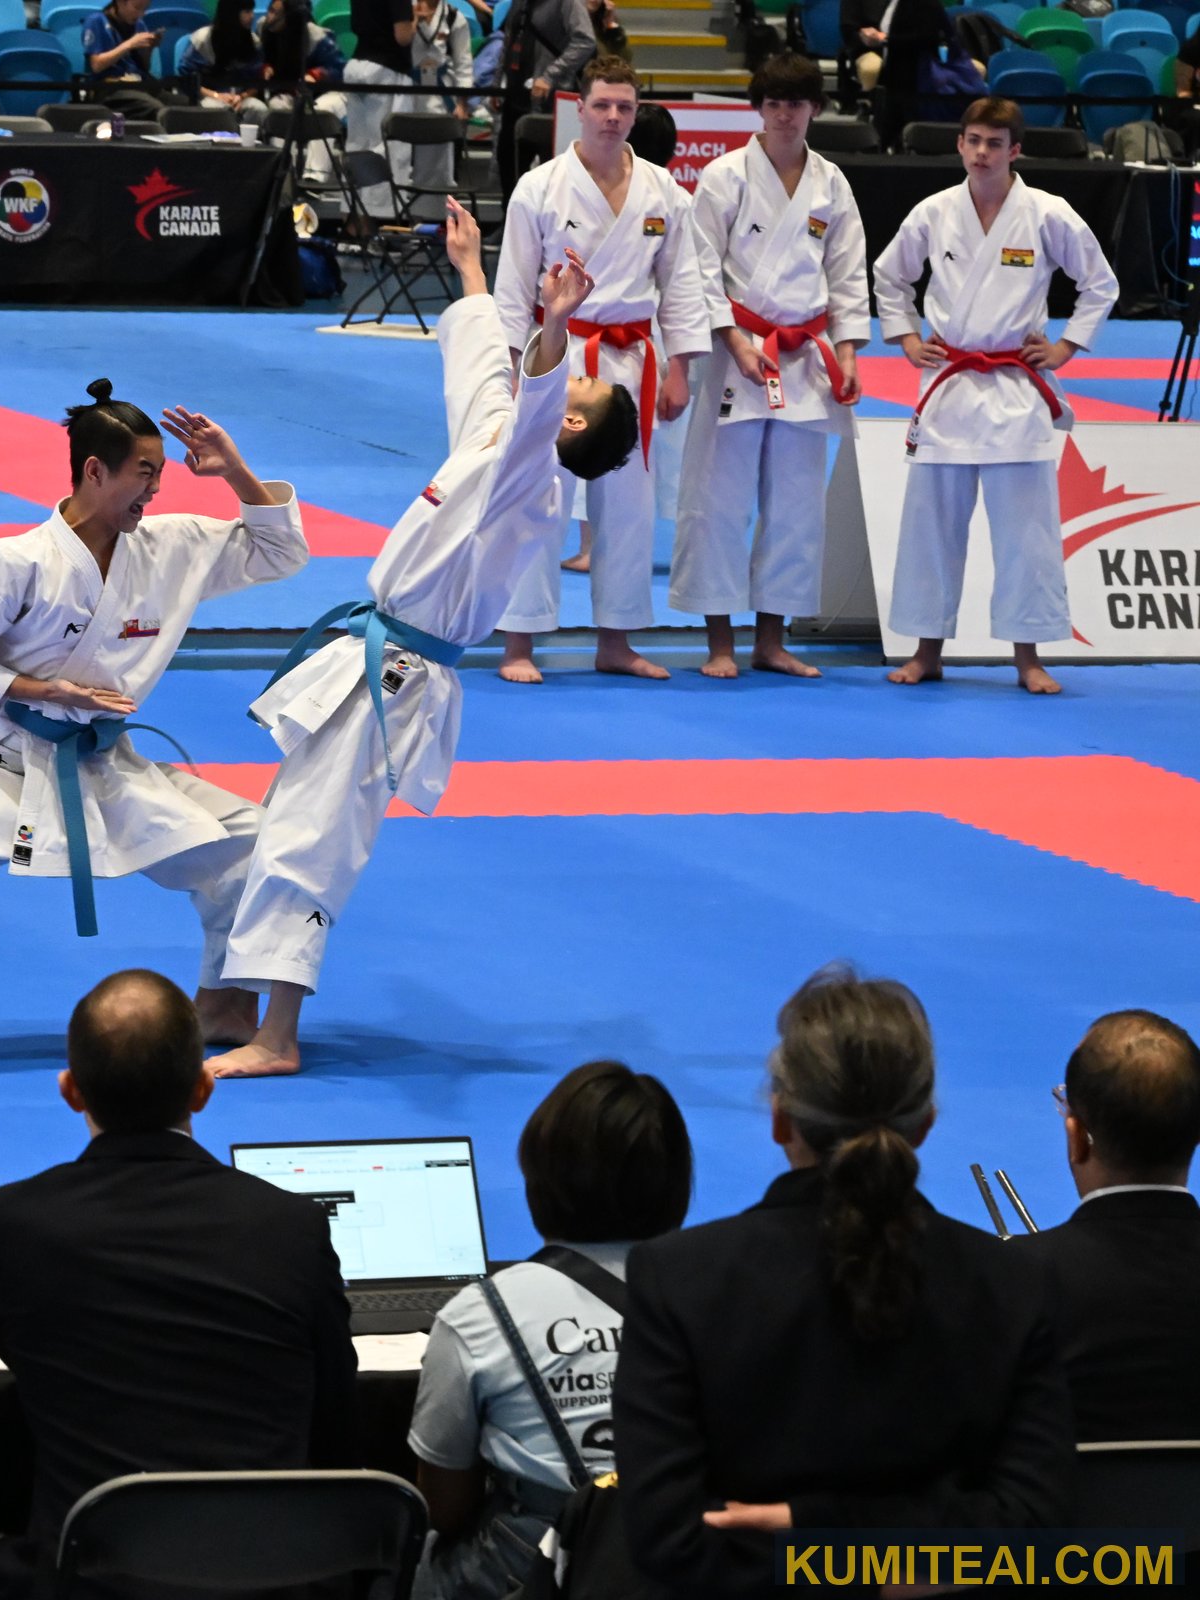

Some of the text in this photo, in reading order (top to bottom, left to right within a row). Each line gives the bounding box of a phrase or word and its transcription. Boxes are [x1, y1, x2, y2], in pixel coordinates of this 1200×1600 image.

[3, 197, 39, 213] WKF
[159, 205, 220, 221] KARATE
[159, 221, 221, 236] CANADA
[1097, 549, 1200, 586] KAR
[1107, 592, 1200, 630] CAN
[552, 1394, 613, 1410] UPPOR
